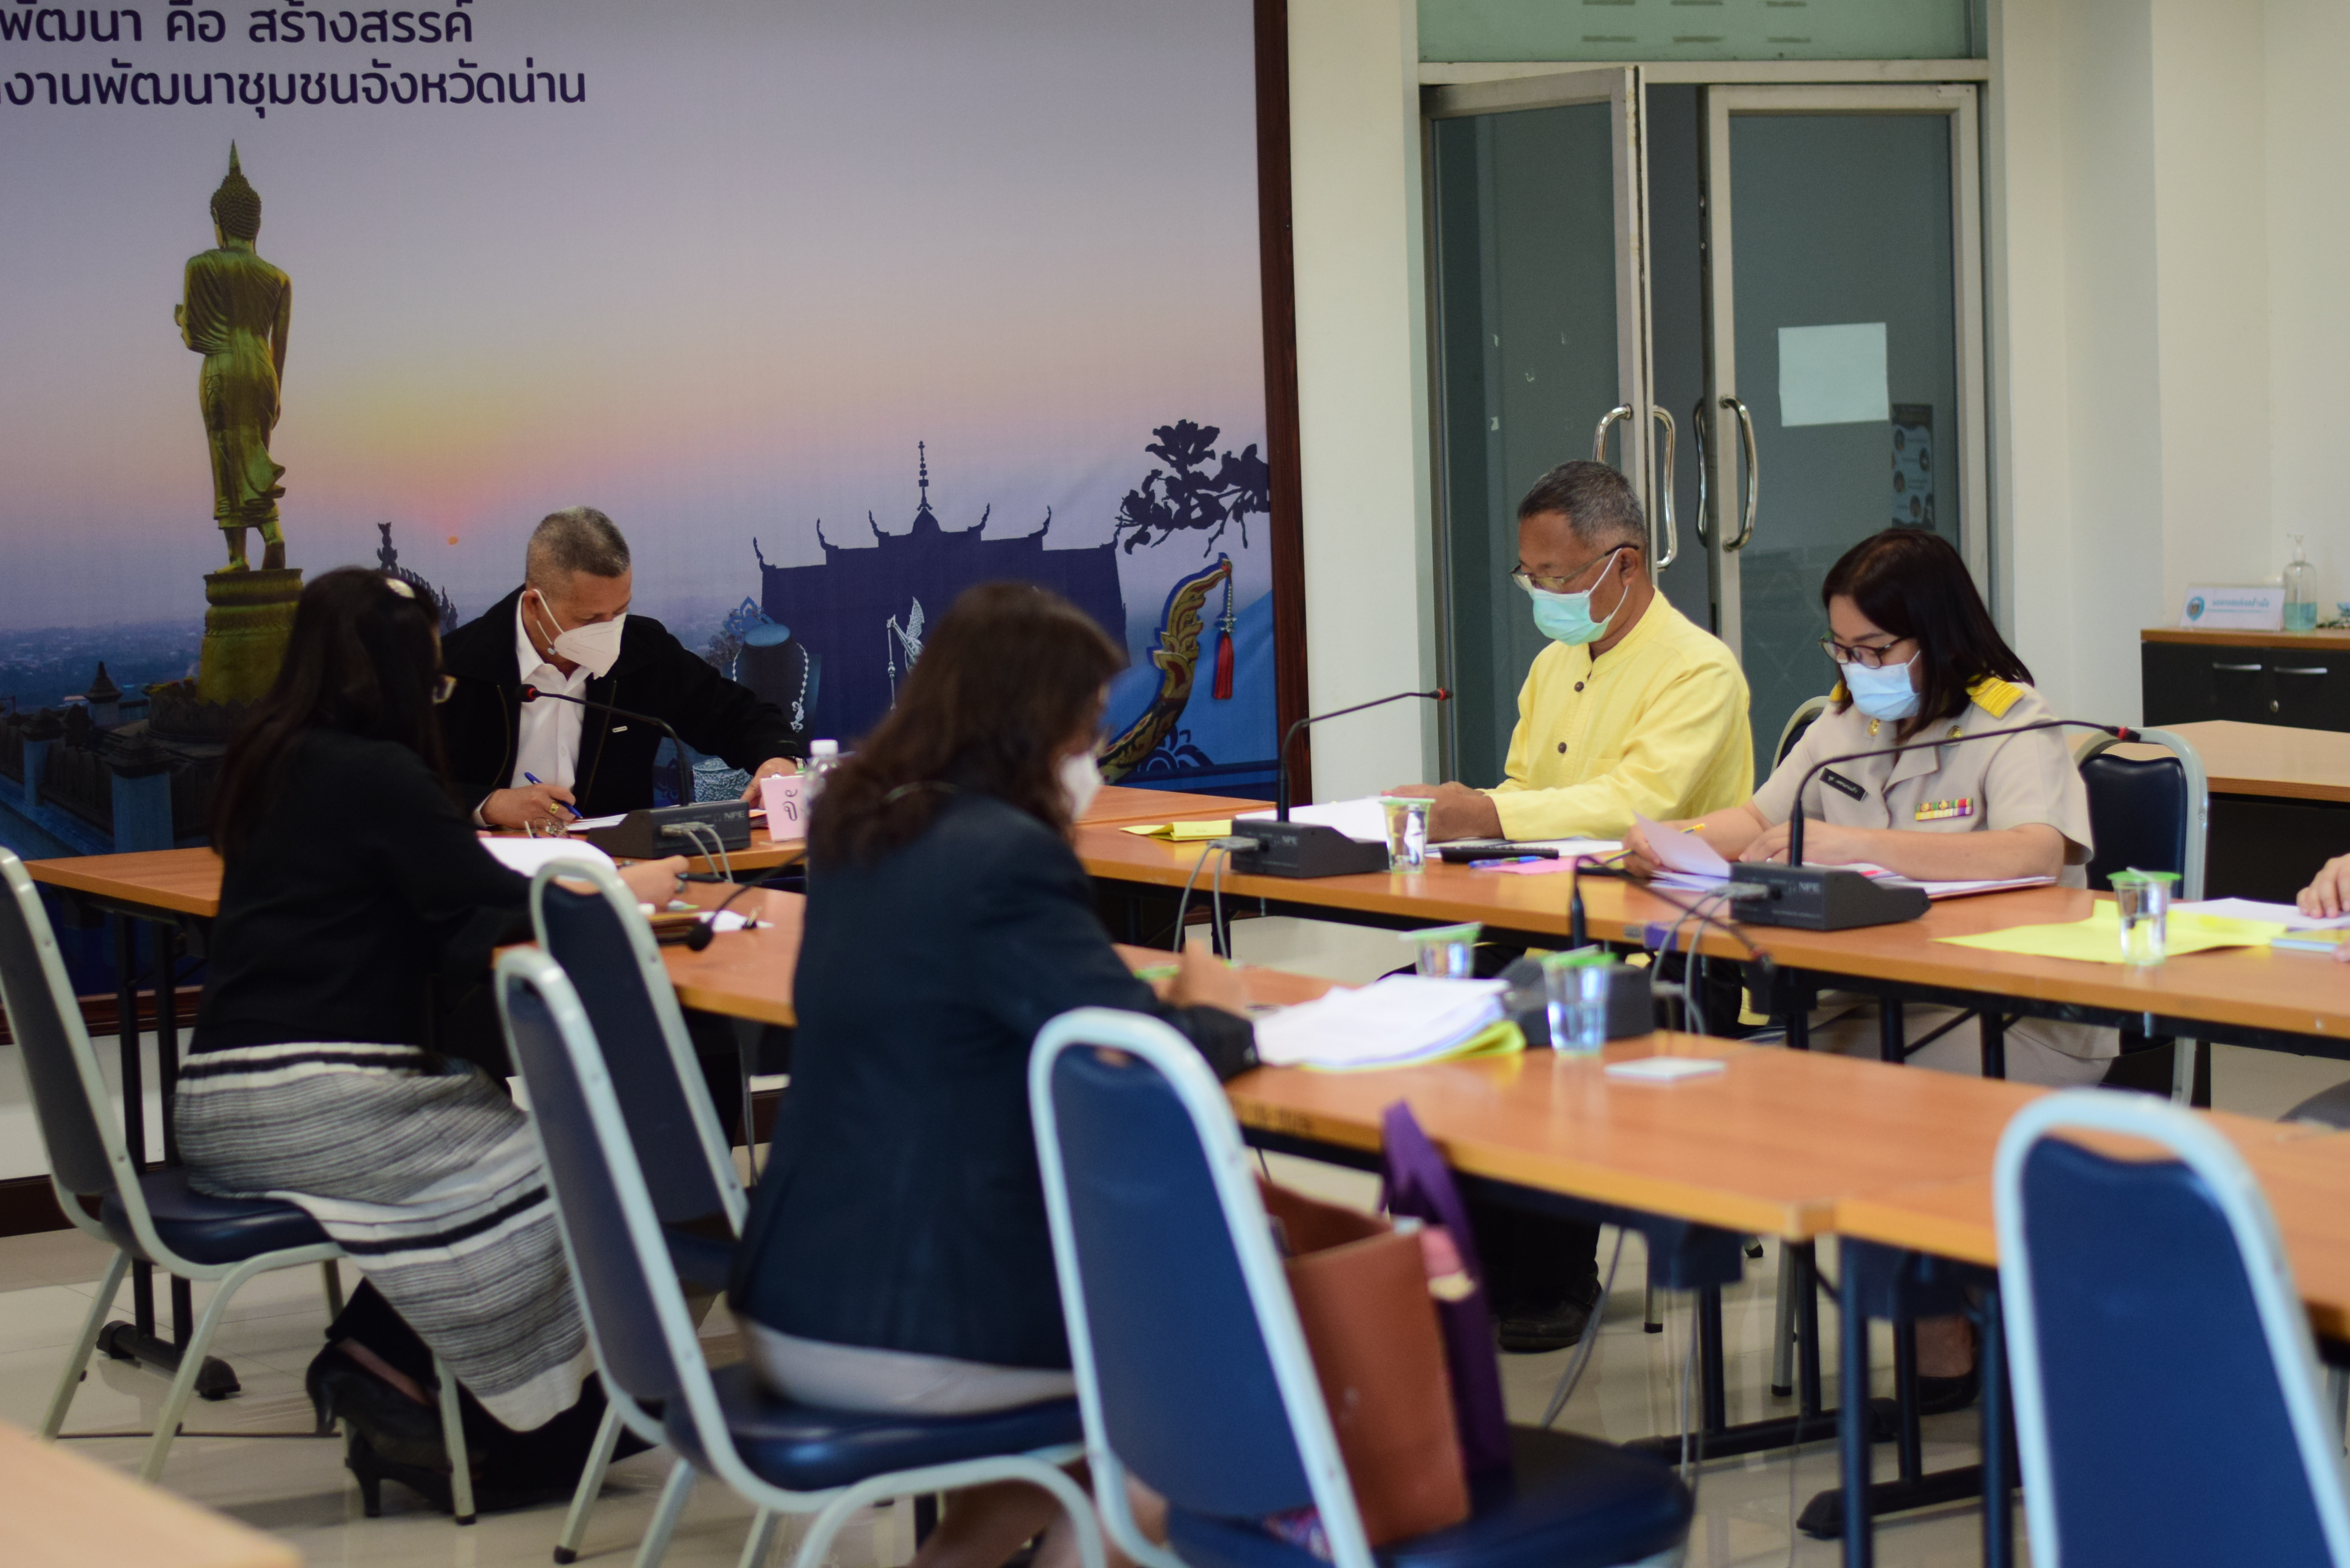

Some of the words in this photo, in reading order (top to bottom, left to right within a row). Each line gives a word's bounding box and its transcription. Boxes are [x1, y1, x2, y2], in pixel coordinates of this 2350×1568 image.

[0, 58, 585, 119] งานพัฒนาชุมชนจังหวัดน่าน
[724, 811, 745, 819] NPE
[783, 789, 805, 821] จั
